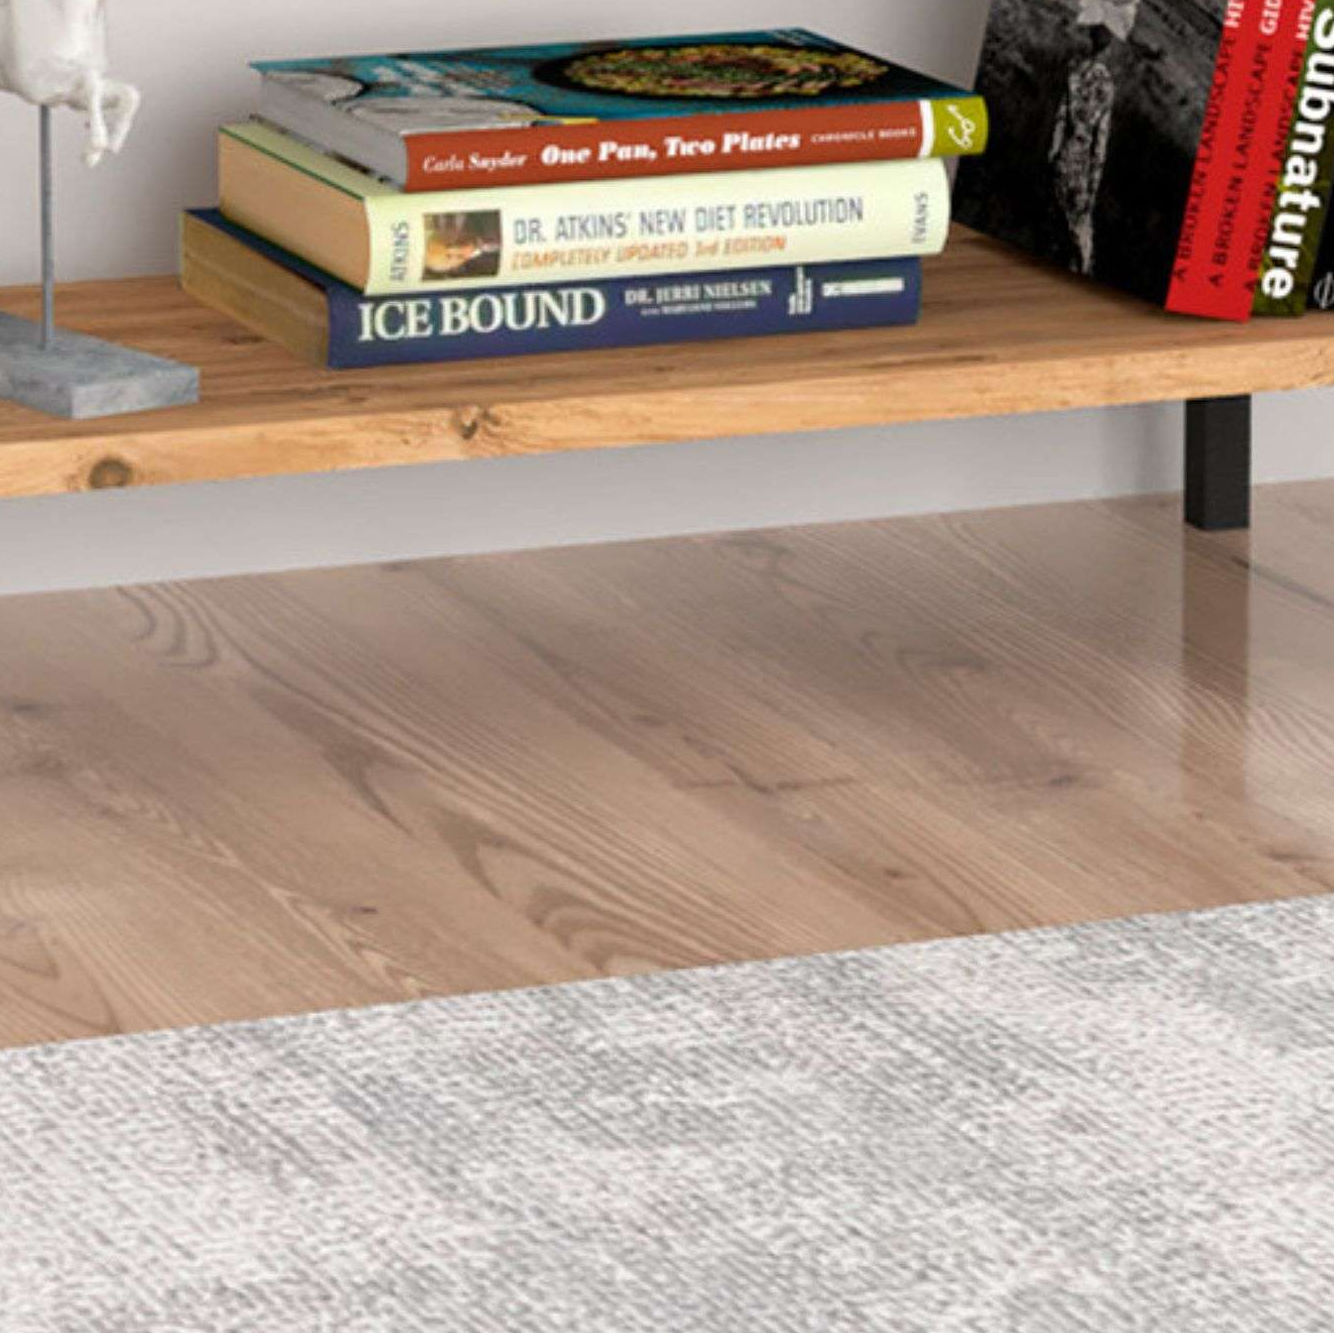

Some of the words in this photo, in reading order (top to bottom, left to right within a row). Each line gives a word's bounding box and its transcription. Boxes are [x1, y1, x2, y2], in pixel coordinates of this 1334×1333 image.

[1232, 41, 1272, 172] LANDSCAPE
[421, 153, 465, 174] Carla
[467, 149, 528, 173] Snyder
[540, 144, 592, 166] One
[597, 140, 658, 163] Pan,
[663, 136, 717, 157] Two
[721, 130, 802, 154] Plates
[513, 218, 547, 245] DR.
[554, 211, 632, 241] ATKINS'
[639, 208, 688, 235] NEW
[694, 205, 737, 233] DIET
[742, 196, 865, 230] REVOLUTION
[910, 191, 930, 245] EVANS
[1213, 177, 1244, 267] BROKEN
[389, 220, 410, 282] ATKINS
[512, 246, 610, 271] COMPLETELY
[616, 240, 689, 263] UPDATED
[722, 235, 788, 256] EDITION
[623, 288, 654, 307] DR.
[1208, 272, 1225, 288] A
[357, 299, 434, 342] ICE
[439, 287, 606, 336] BOUND
